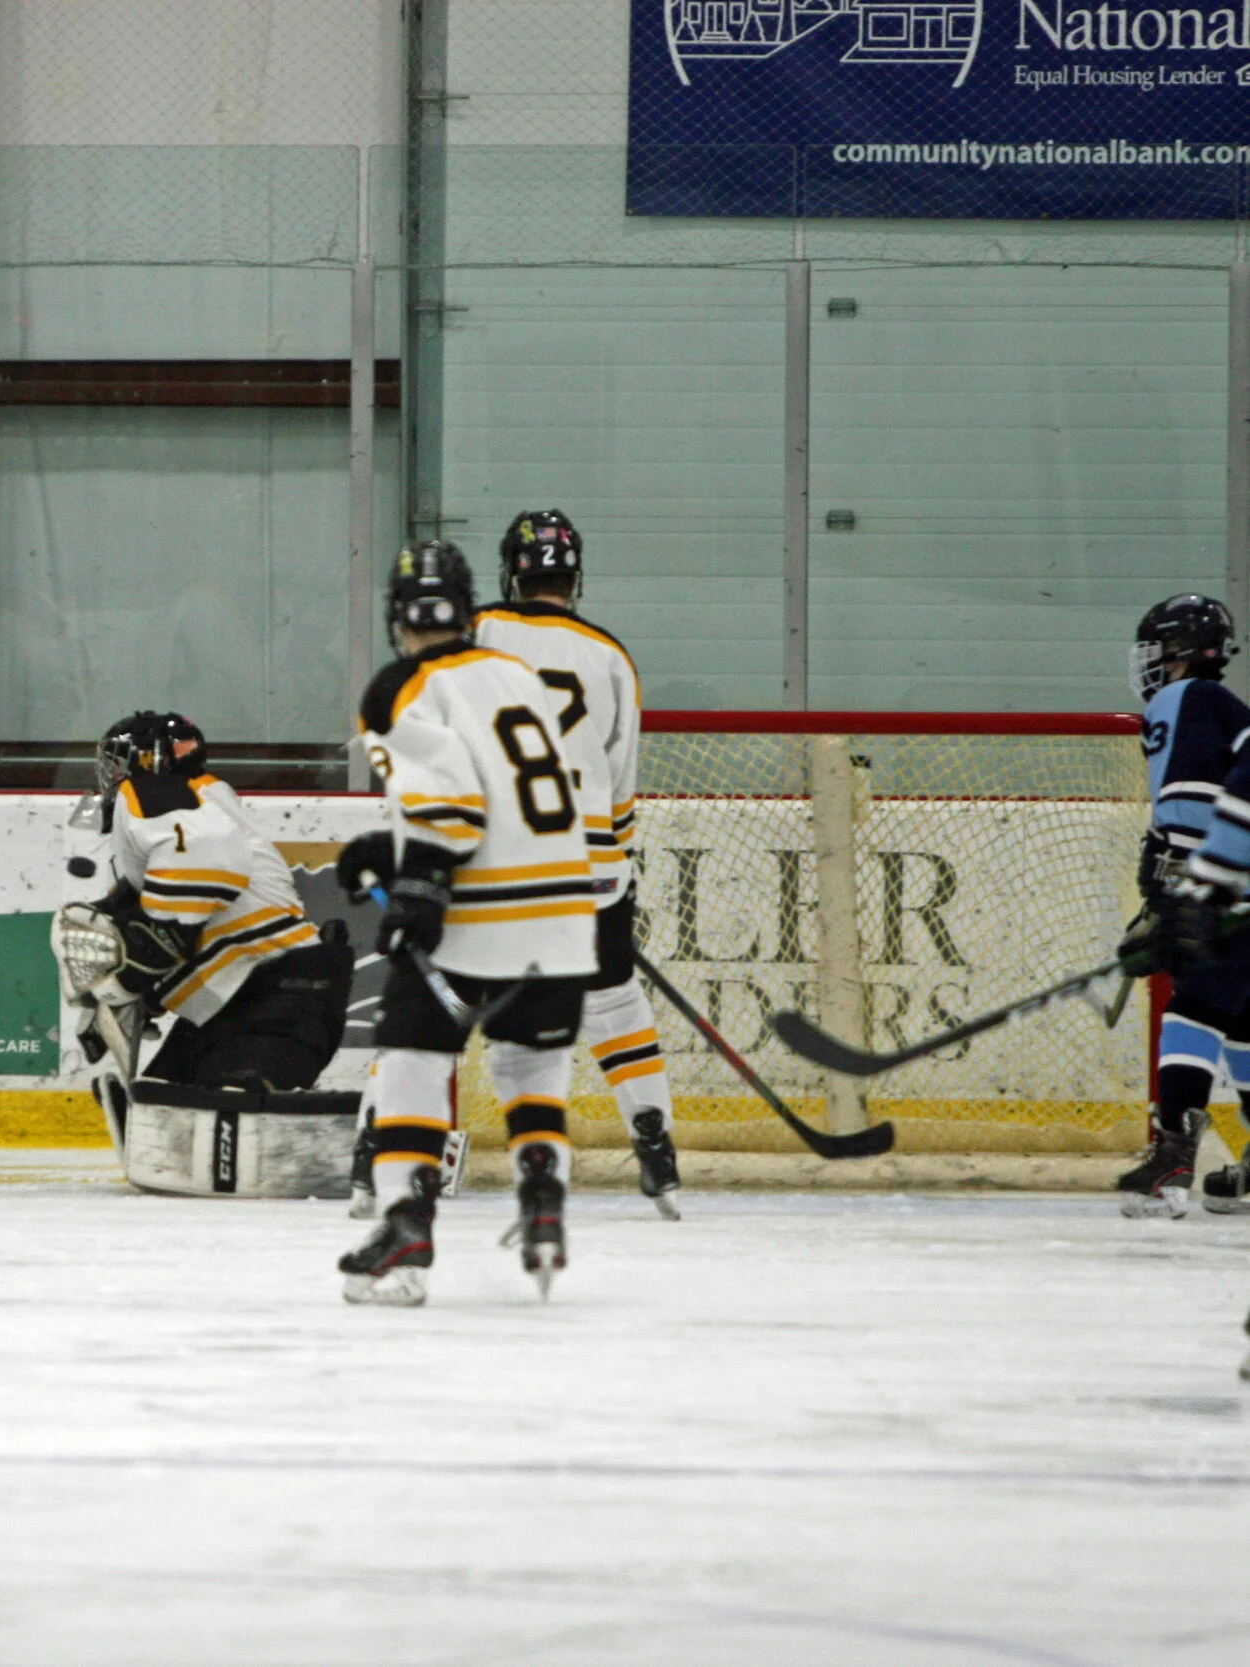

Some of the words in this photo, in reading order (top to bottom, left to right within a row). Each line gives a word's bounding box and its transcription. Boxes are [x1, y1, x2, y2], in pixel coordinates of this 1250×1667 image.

[1015, 0, 1250, 50] National
[1015, 65, 1069, 90] Equal
[1073, 65, 1154, 90] Housing
[1159, 65, 1226, 85] Lender
[542, 544, 557, 567] 2
[493, 705, 577, 836] 8
[173, 822, 187, 853] 1
[632, 847, 972, 967] LER
[219, 1119, 233, 1181] CCM
